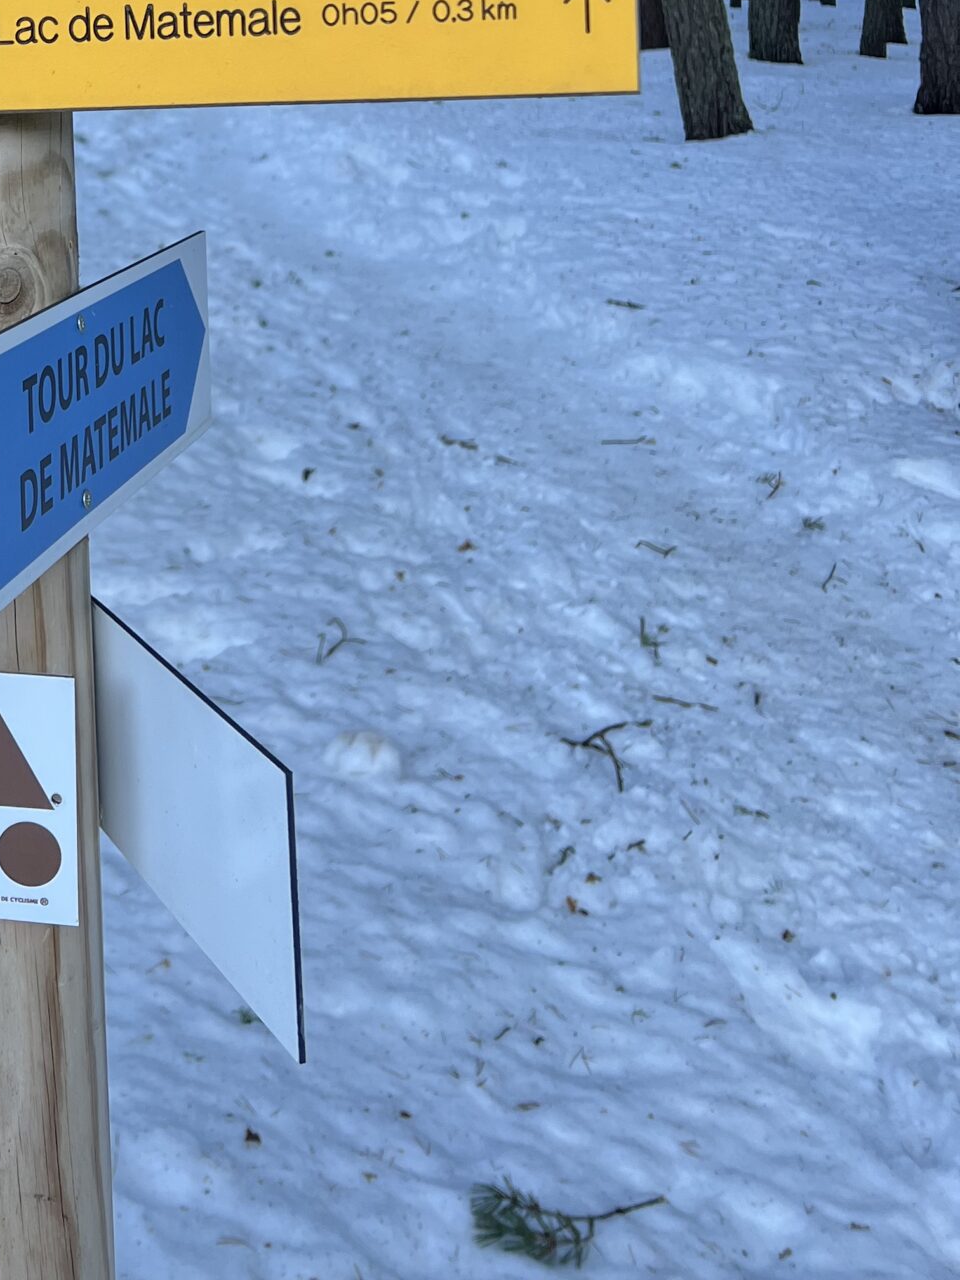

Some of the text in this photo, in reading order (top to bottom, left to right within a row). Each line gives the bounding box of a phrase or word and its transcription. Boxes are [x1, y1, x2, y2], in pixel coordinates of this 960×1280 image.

[68, 6, 115, 43] de
[123, 0, 302, 41] Matemale
[321, 1, 398, 27] 0h05
[405, 0, 420, 24] /
[21, 298, 166, 434] TOUR DU LAC
[19, 368, 172, 533] DE MATEMALE
[10, 896, 39, 905] CYCLISME
